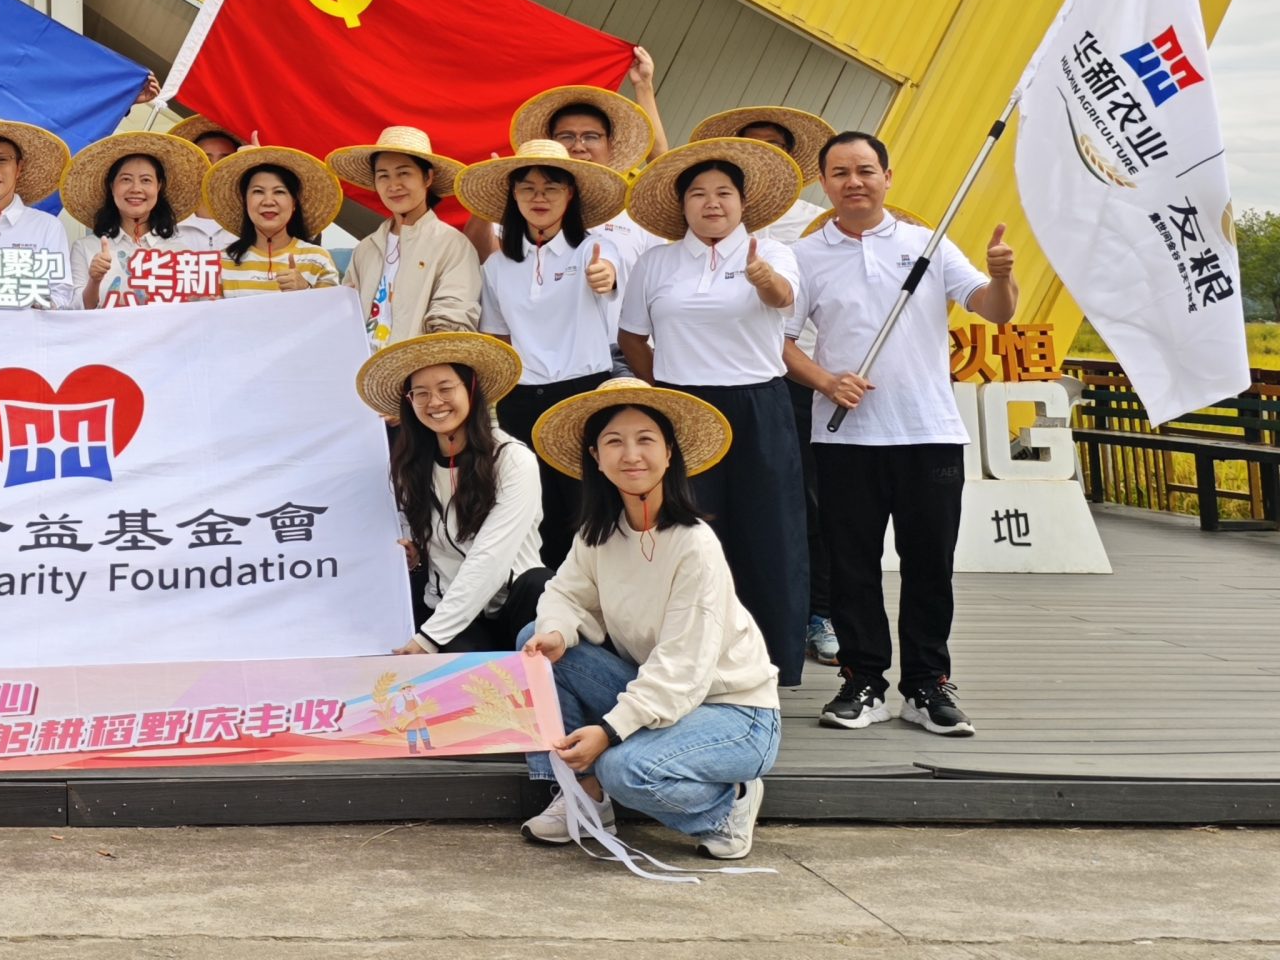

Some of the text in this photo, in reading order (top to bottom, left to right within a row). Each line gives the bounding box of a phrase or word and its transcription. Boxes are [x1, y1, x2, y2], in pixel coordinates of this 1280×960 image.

[1060, 54, 1139, 176] HUAXIN AGRICULTURE
[1073, 30, 1169, 168] 华新农业
[129, 250, 220, 296] 华新
[1167, 195, 1234, 307] 友粮
[991, 508, 1032, 547] 地
[108, 554, 339, 592] Foundation
